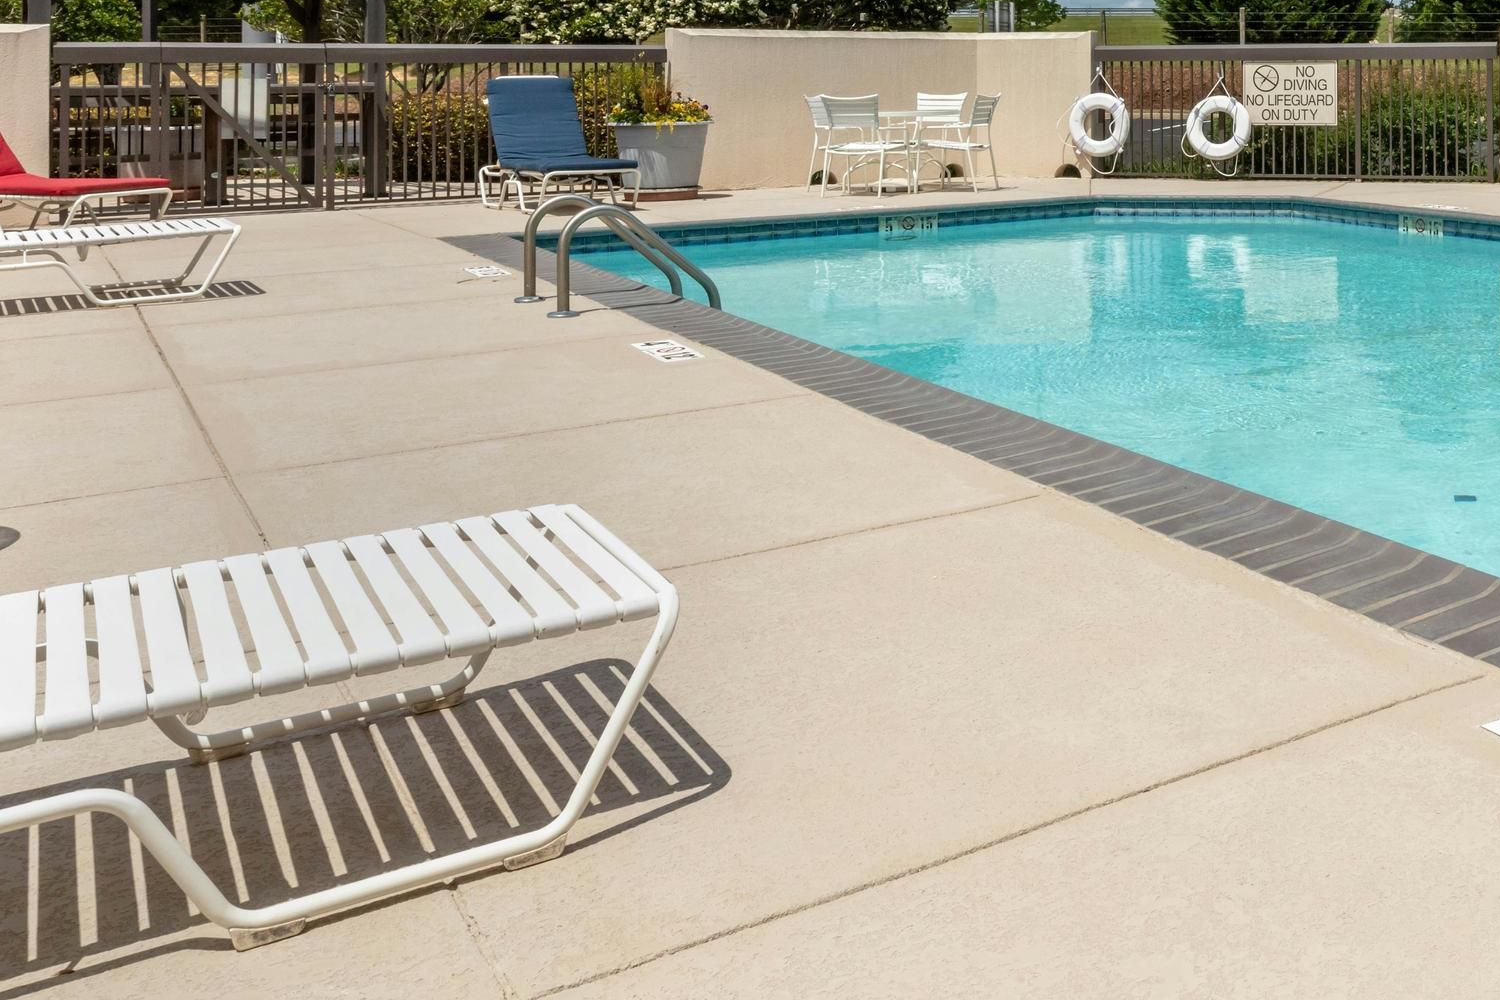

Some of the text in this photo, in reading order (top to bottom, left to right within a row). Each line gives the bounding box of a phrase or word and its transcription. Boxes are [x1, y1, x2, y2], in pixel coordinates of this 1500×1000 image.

[1295, 66, 1315, 78] NO
[1283, 79, 1328, 91] DIVING
[1246, 94, 1334, 106] NO LIFEGUARD
[1261, 109, 1318, 121] ON DUTY
